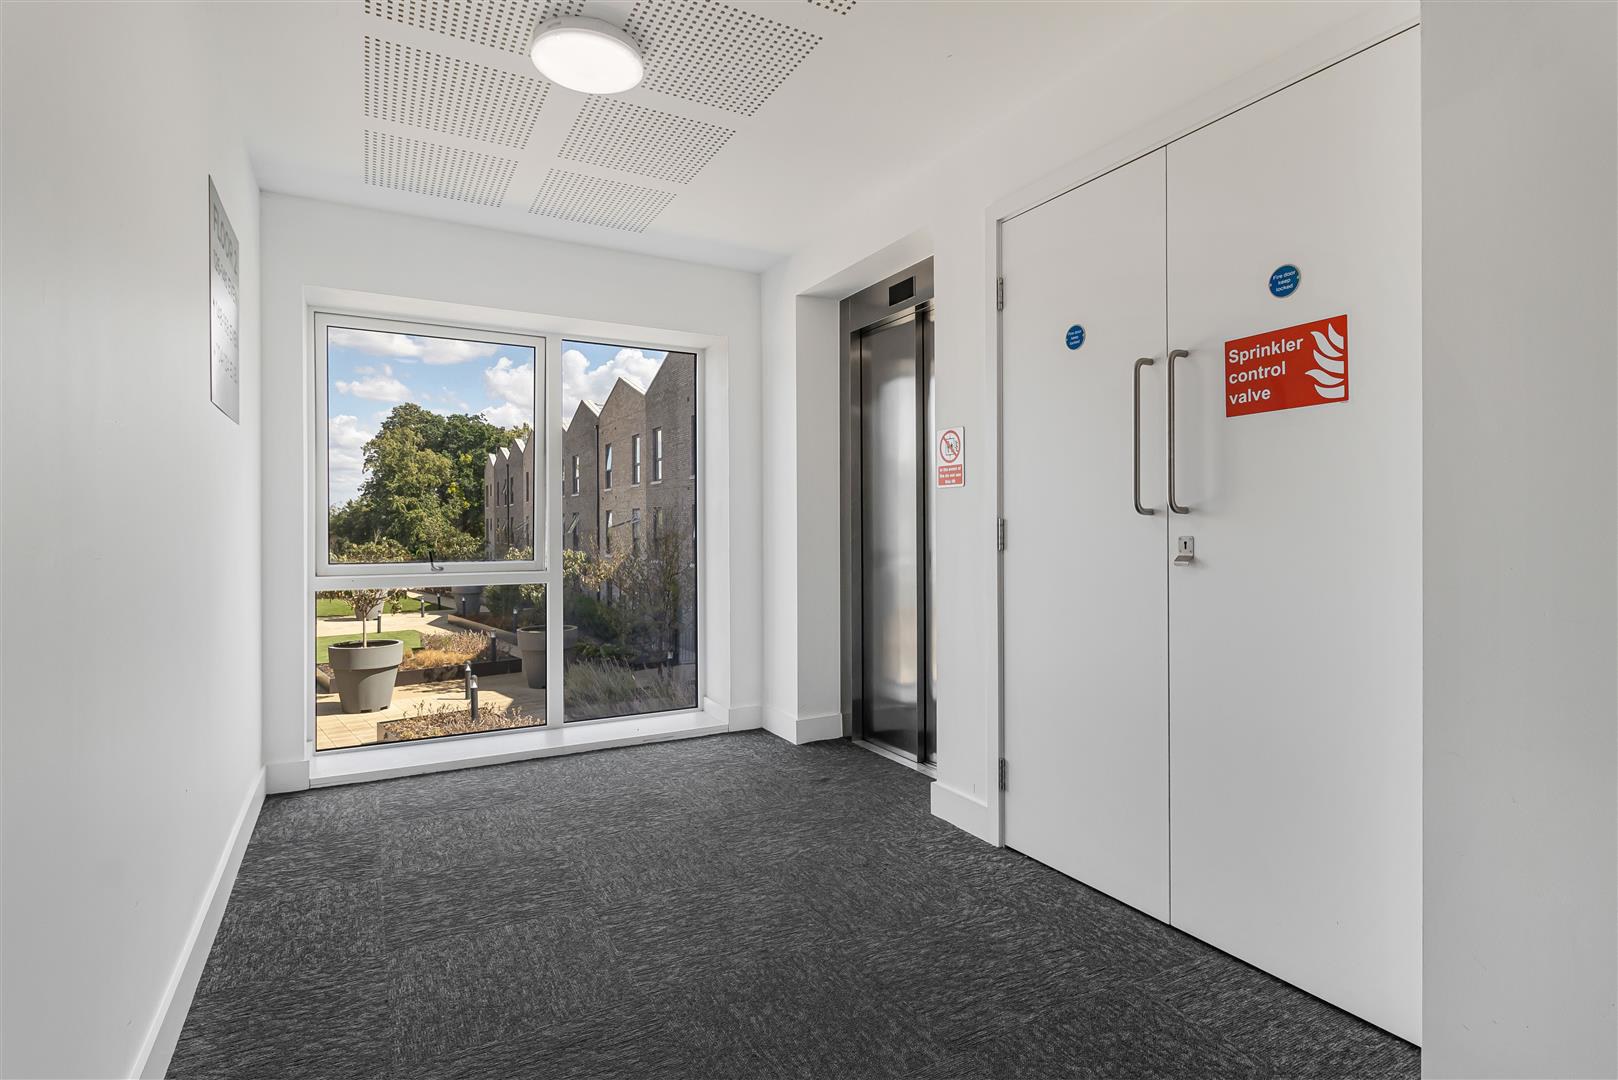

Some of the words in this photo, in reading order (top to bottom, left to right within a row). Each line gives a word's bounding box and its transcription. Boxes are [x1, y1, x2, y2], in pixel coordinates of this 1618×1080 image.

[213, 202, 233, 263] FLOOR
[1276, 283, 1293, 291] locked
[1228, 338, 1304, 365] Sprinkler
[1229, 361, 1286, 384] control
[1229, 388, 1271, 405] valve
